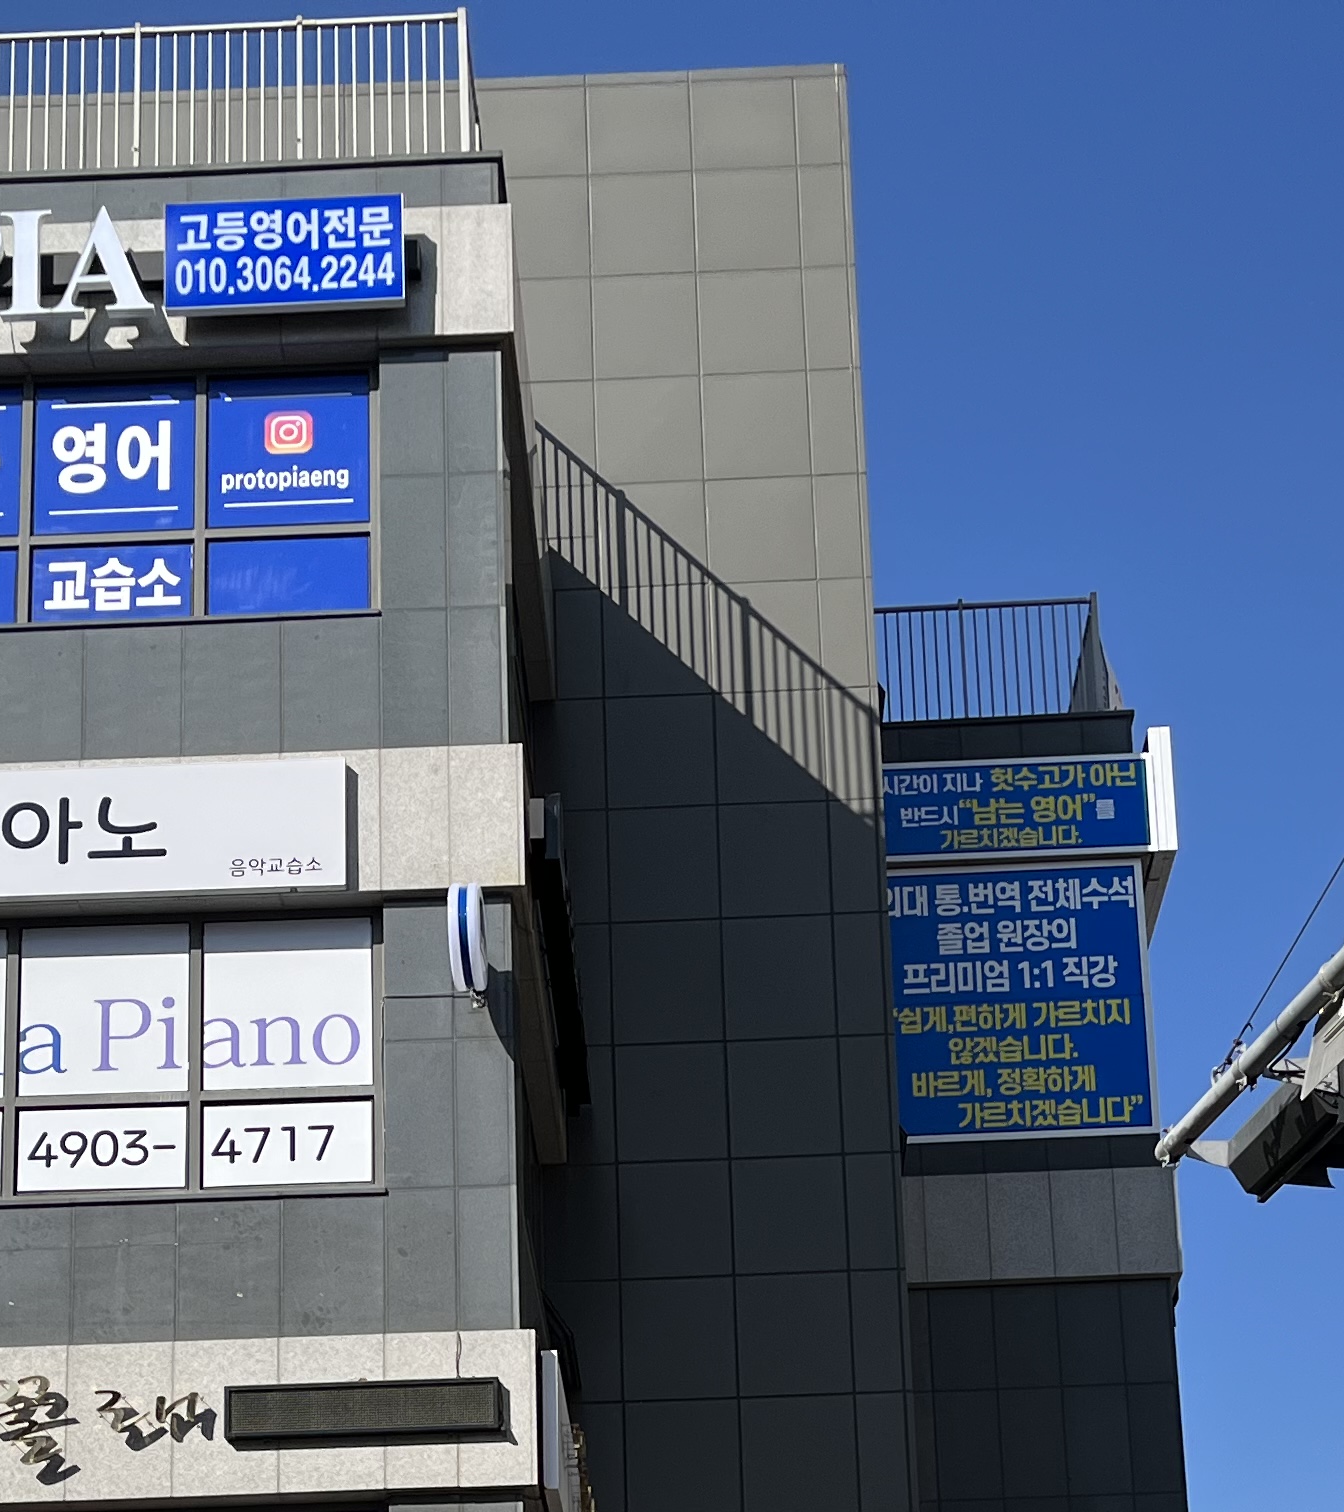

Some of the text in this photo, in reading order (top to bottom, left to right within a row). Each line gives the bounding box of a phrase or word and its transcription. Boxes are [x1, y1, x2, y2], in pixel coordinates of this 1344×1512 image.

[176, 204, 394, 252] 고등영어전문
[174, 253, 396, 296] 010.3064.2244
[51, 419, 172, 494] 영어
[220, 463, 350, 493] protopiaeng
[43, 556, 182, 611] 교습소
[883, 761, 1137, 797] 시간이 지나 헛수고가 아닌
[900, 805, 959, 828] 반드시
[229, 857, 323, 878] 음악교습소
[1027, 875, 1135, 912] 전체수석
[936, 917, 1077, 956] 졸업 원장의
[903, 955, 1119, 995] 프리미엄 1:1 직강
[1033, 998, 1131, 1028] 가르치지
[91, 996, 362, 1073] Piano
[912, 1065, 1097, 1098] 바르게, 정확하게
